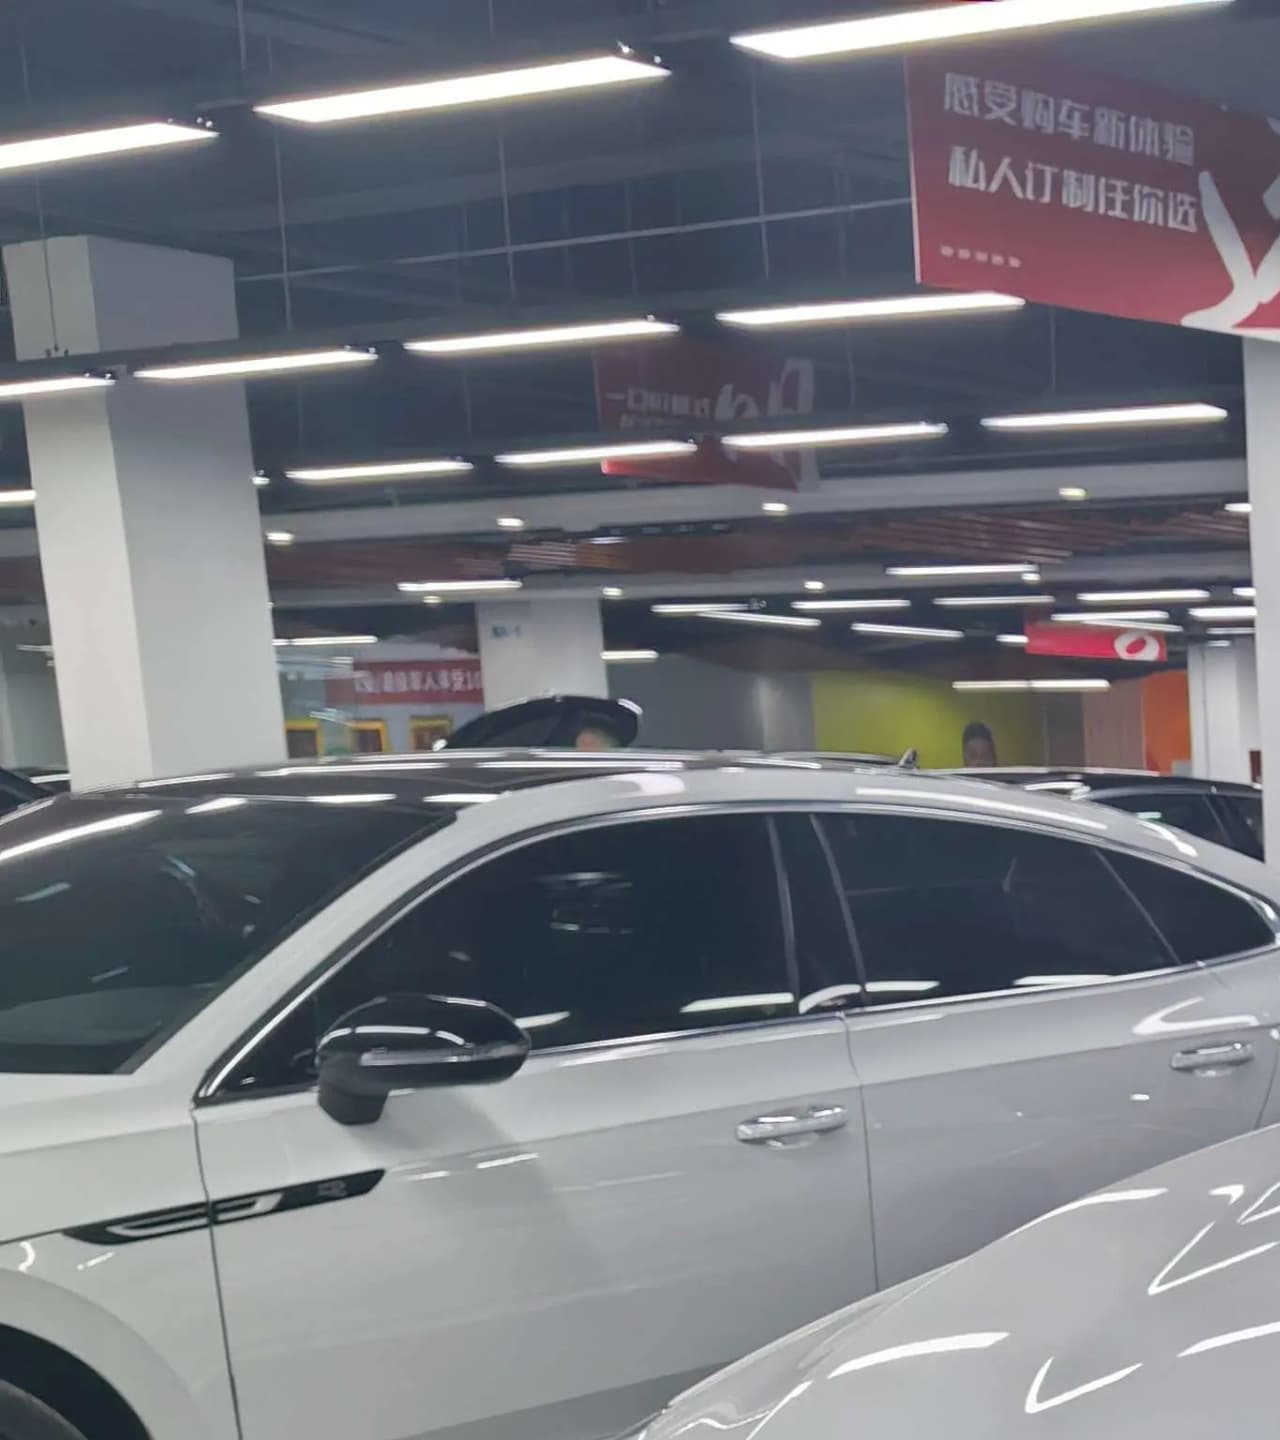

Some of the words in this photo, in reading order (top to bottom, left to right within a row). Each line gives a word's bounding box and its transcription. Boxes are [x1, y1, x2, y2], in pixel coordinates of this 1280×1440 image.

[944, 72, 1194, 167] 感受购车新体验
[948, 145, 1198, 233] 私人订制任你选
